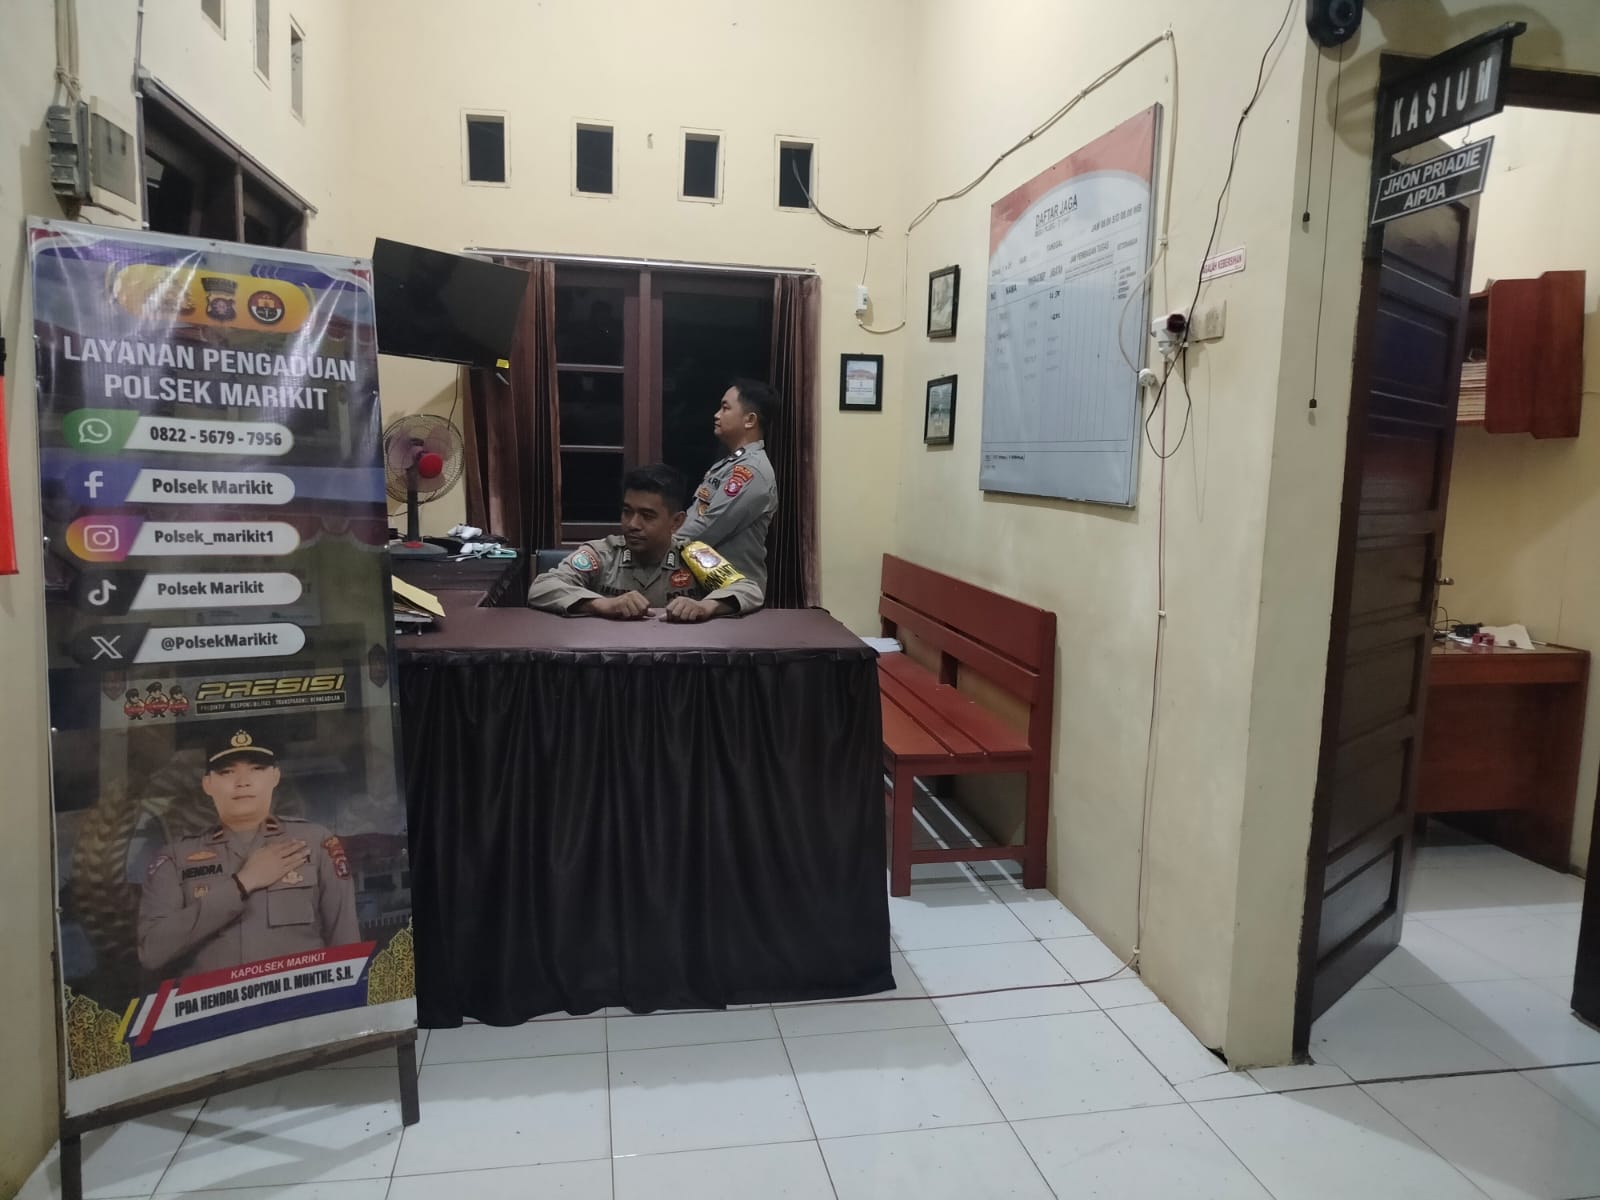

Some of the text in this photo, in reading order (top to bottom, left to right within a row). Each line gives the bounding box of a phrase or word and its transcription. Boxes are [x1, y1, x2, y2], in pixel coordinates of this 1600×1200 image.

[1391, 56, 1493, 138] KASIUM
[1383, 147, 1481, 196] JHON PRIADIE
[1403, 182, 1446, 210] AIPDA
[1035, 203, 1059, 229] DAFTAR
[1060, 194, 1078, 216] JAGA
[64, 336, 357, 382] LAYANAN PENGADUAN
[104, 374, 327, 410] POLSEK MARIKIT
[150, 426, 186, 442] 0822
[200, 430, 235, 444] 5679
[247, 432, 282, 446] 7956
[152, 478, 274, 495] Polsek Marikit
[154, 529, 274, 546] Polsek_marikit1
[157, 580, 264, 596] Polsek Marikit
[161, 632, 279, 651] @PolsekMarikit
[197, 674, 345, 700] PRESISI
[182, 863, 223, 880] HENDRA
[230, 952, 327, 979] KAPOLSEK MARIKIT
[174, 1000, 199, 1017] IPDA
[200, 989, 240, 1014] HENDRA
[240, 977, 281, 1001] SOPIYAN
[283, 977, 293, 991] D.
[336, 966, 354, 982] S.H.
